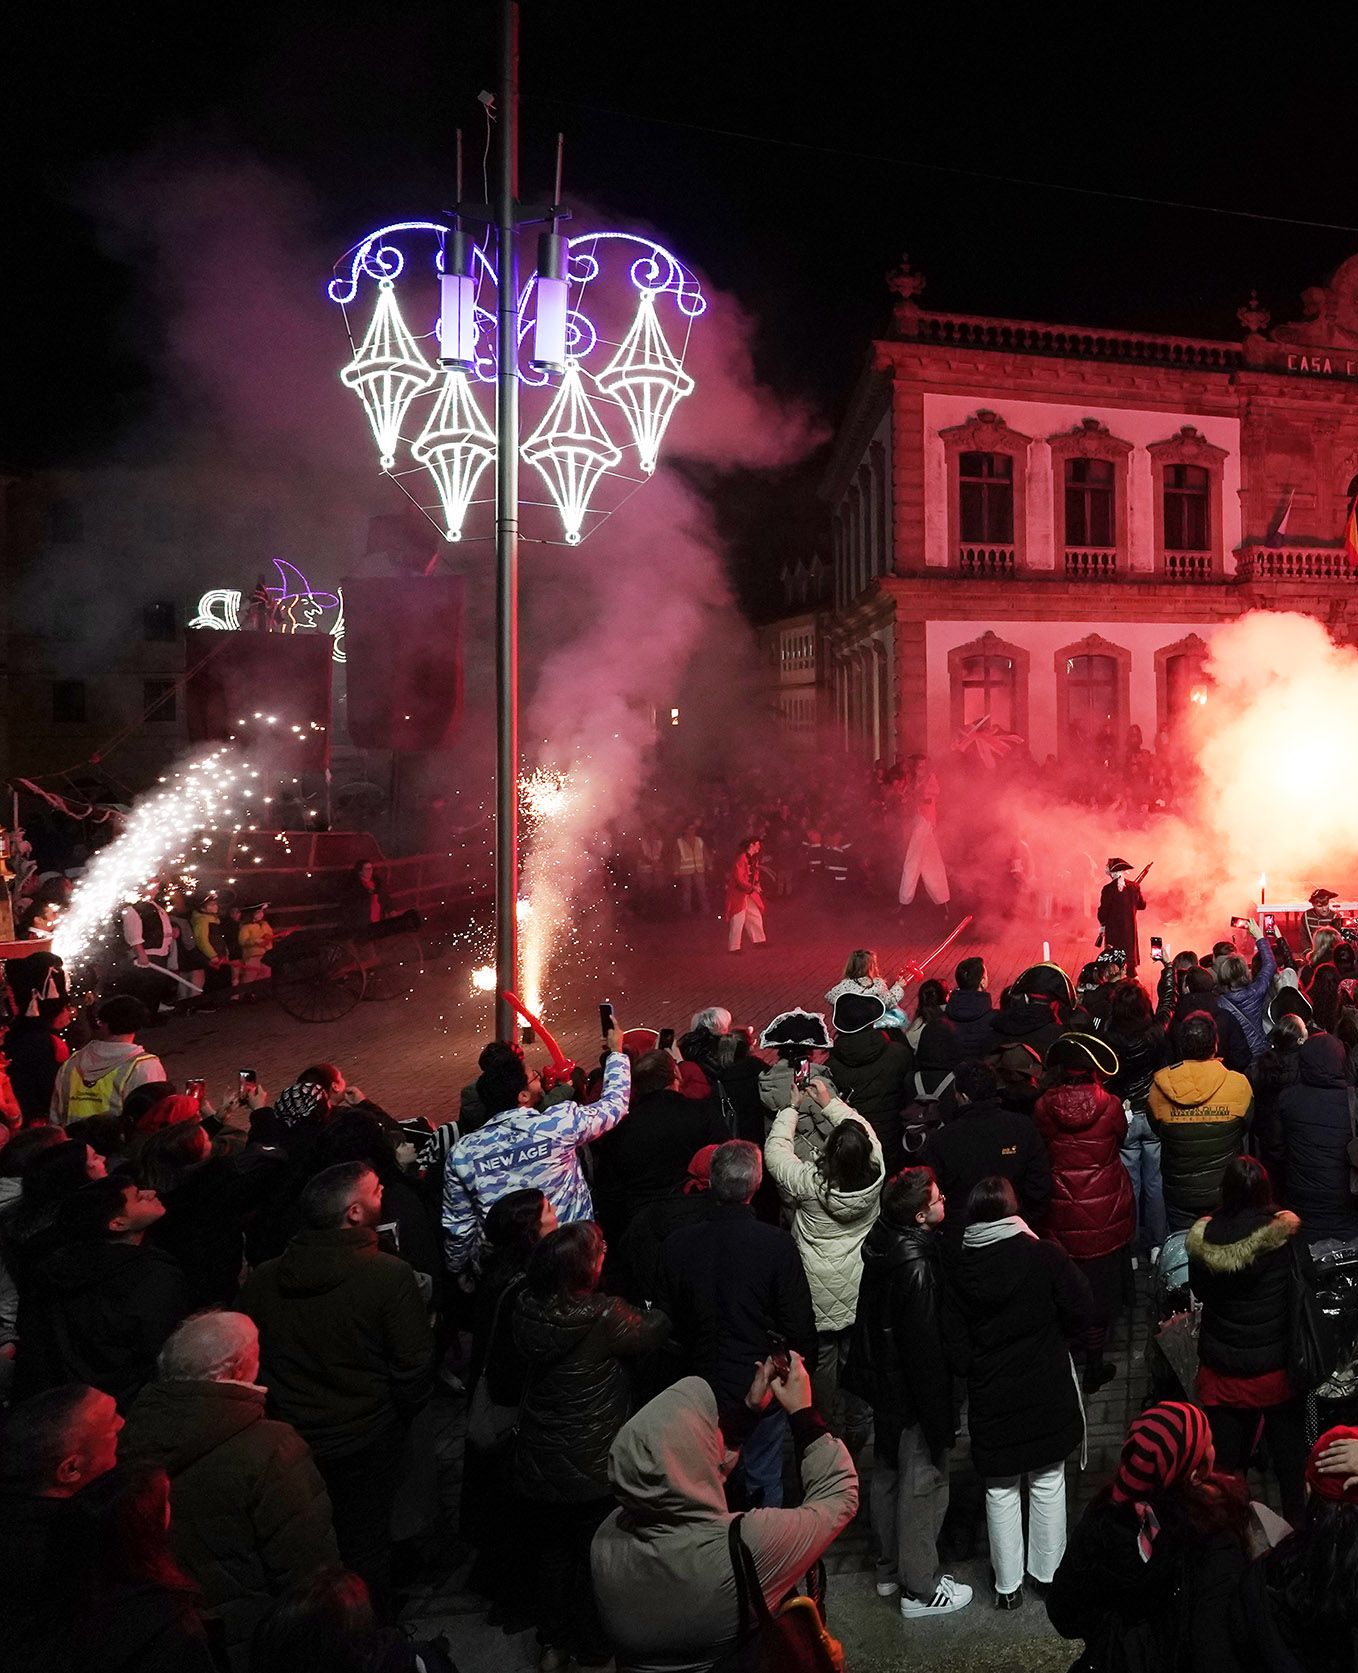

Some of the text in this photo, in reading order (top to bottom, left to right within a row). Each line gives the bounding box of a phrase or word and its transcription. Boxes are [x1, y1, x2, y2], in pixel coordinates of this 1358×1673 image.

[1287, 354, 1332, 374] CASA
[479, 1143, 548, 1173] NEW AGE
